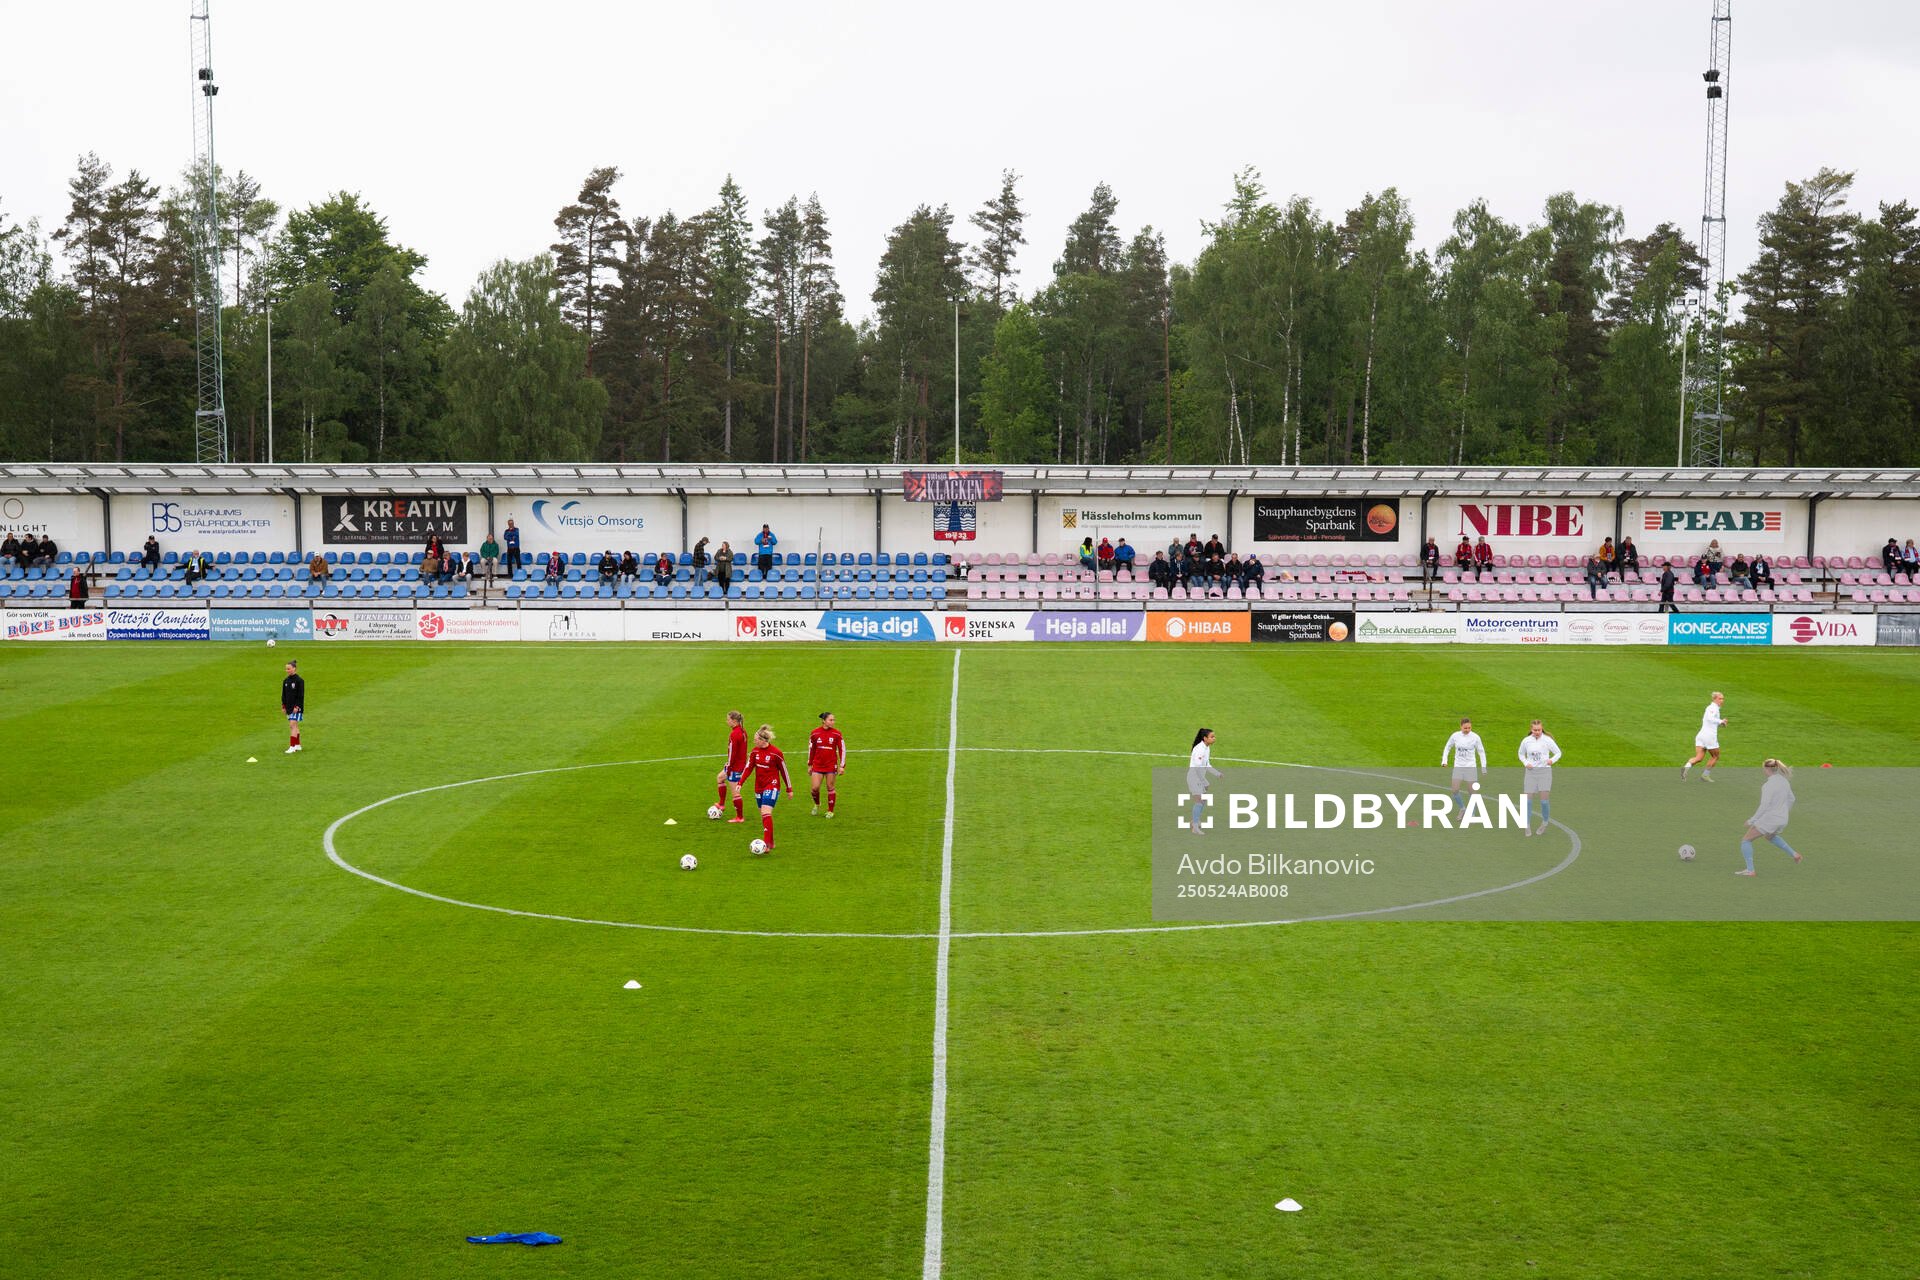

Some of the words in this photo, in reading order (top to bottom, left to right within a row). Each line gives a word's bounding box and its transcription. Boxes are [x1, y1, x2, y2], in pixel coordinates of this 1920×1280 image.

[927, 479, 982, 500] KLACKEN
[364, 501, 457, 517] KREATIV
[1258, 506, 1357, 519] Snapphanebygdens
[558, 515, 594, 528] Vittsjö
[597, 515, 644, 528] Omsorg
[1081, 511, 1151, 520] Hässleholms
[1153, 512, 1202, 520] kommun
[1457, 505, 1583, 536] NIBE
[1660, 511, 1765, 530] PEAB
[183, 518, 271, 527] STÅLPRODUKTER
[365, 522, 454, 532] REKLAM
[1306, 520, 1356, 532] Sparbank
[8, 620, 55, 638] RÖKE
[58, 612, 103, 630] BUSS
[108, 611, 151, 627] Vittsjö
[152, 611, 207, 628] Camping
[211, 617, 263, 625] Vårdcentralen
[264, 617, 290, 626] Vittsjö
[761, 620, 807, 628] SVENSKA
[1467, 618, 1558, 627] Motorcentrum
[838, 616, 879, 637] Heja
[881, 616, 918, 637] dig!
[1046, 617, 1087, 638] Heja
[1090, 617, 1126, 634] alla!
[1188, 622, 1231, 634] HIBAB
[1257, 622, 1322, 632] Snapphanebygdens
[1379, 625, 1457, 634] SKÅNEGÅRDAR
[1673, 622, 1768, 634] KONECRANES
[1816, 621, 1858, 637] VIDA
[761, 629, 785, 637] SPEL
[1289, 631, 1322, 640] Sparbank
